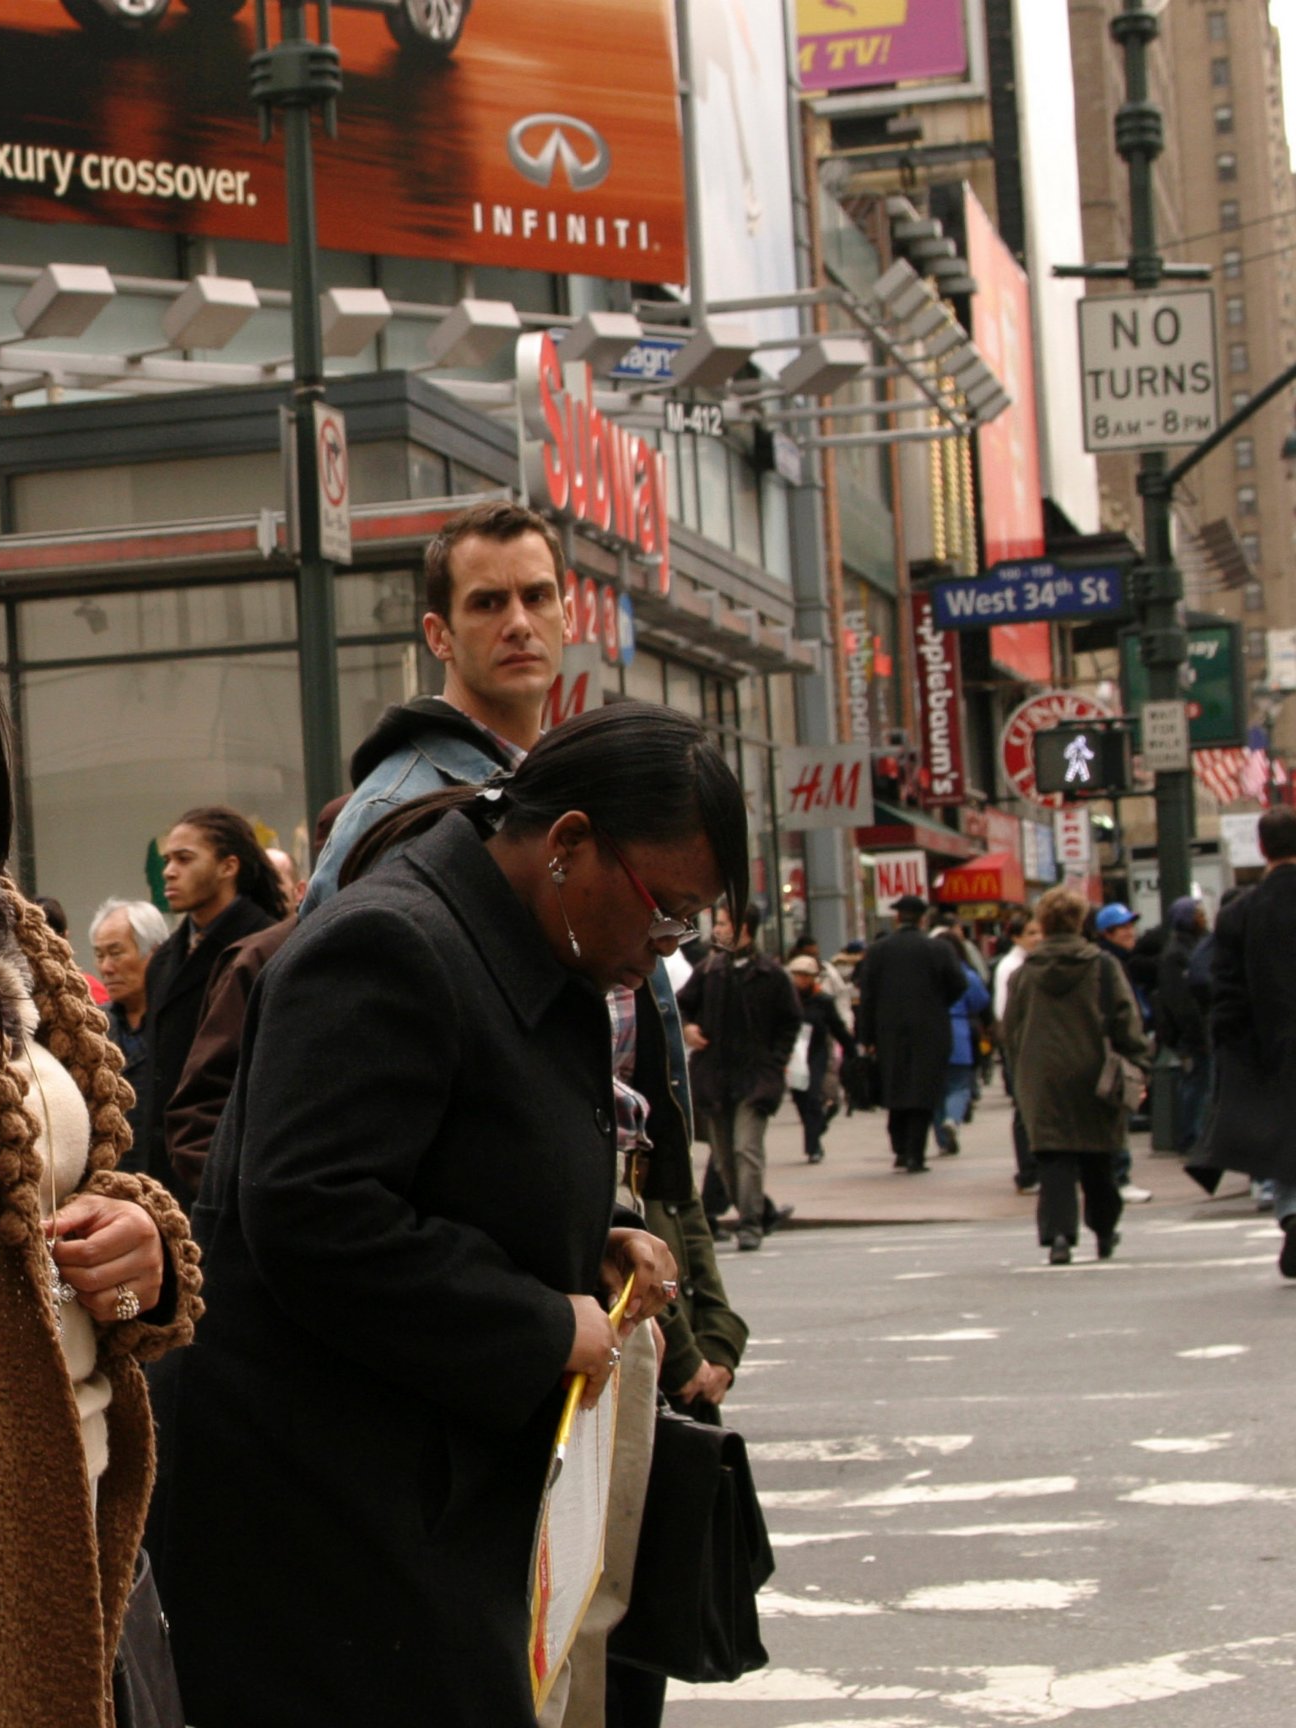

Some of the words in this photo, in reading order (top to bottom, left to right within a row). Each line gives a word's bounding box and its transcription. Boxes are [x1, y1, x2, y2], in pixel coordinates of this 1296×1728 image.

[826, 34, 893, 70] TV!
[80, 153, 257, 206] crossover.
[472, 203, 649, 250] INFINITI
[1112, 308, 1181, 351] NO
[1087, 362, 1212, 401] TURNS
[666, 401, 724, 437] M-412
[945, 586, 1017, 617] West
[1023, 577, 1074, 611] 34th
[1080, 575, 1110, 606] St
[790, 761, 863, 815] H&M
